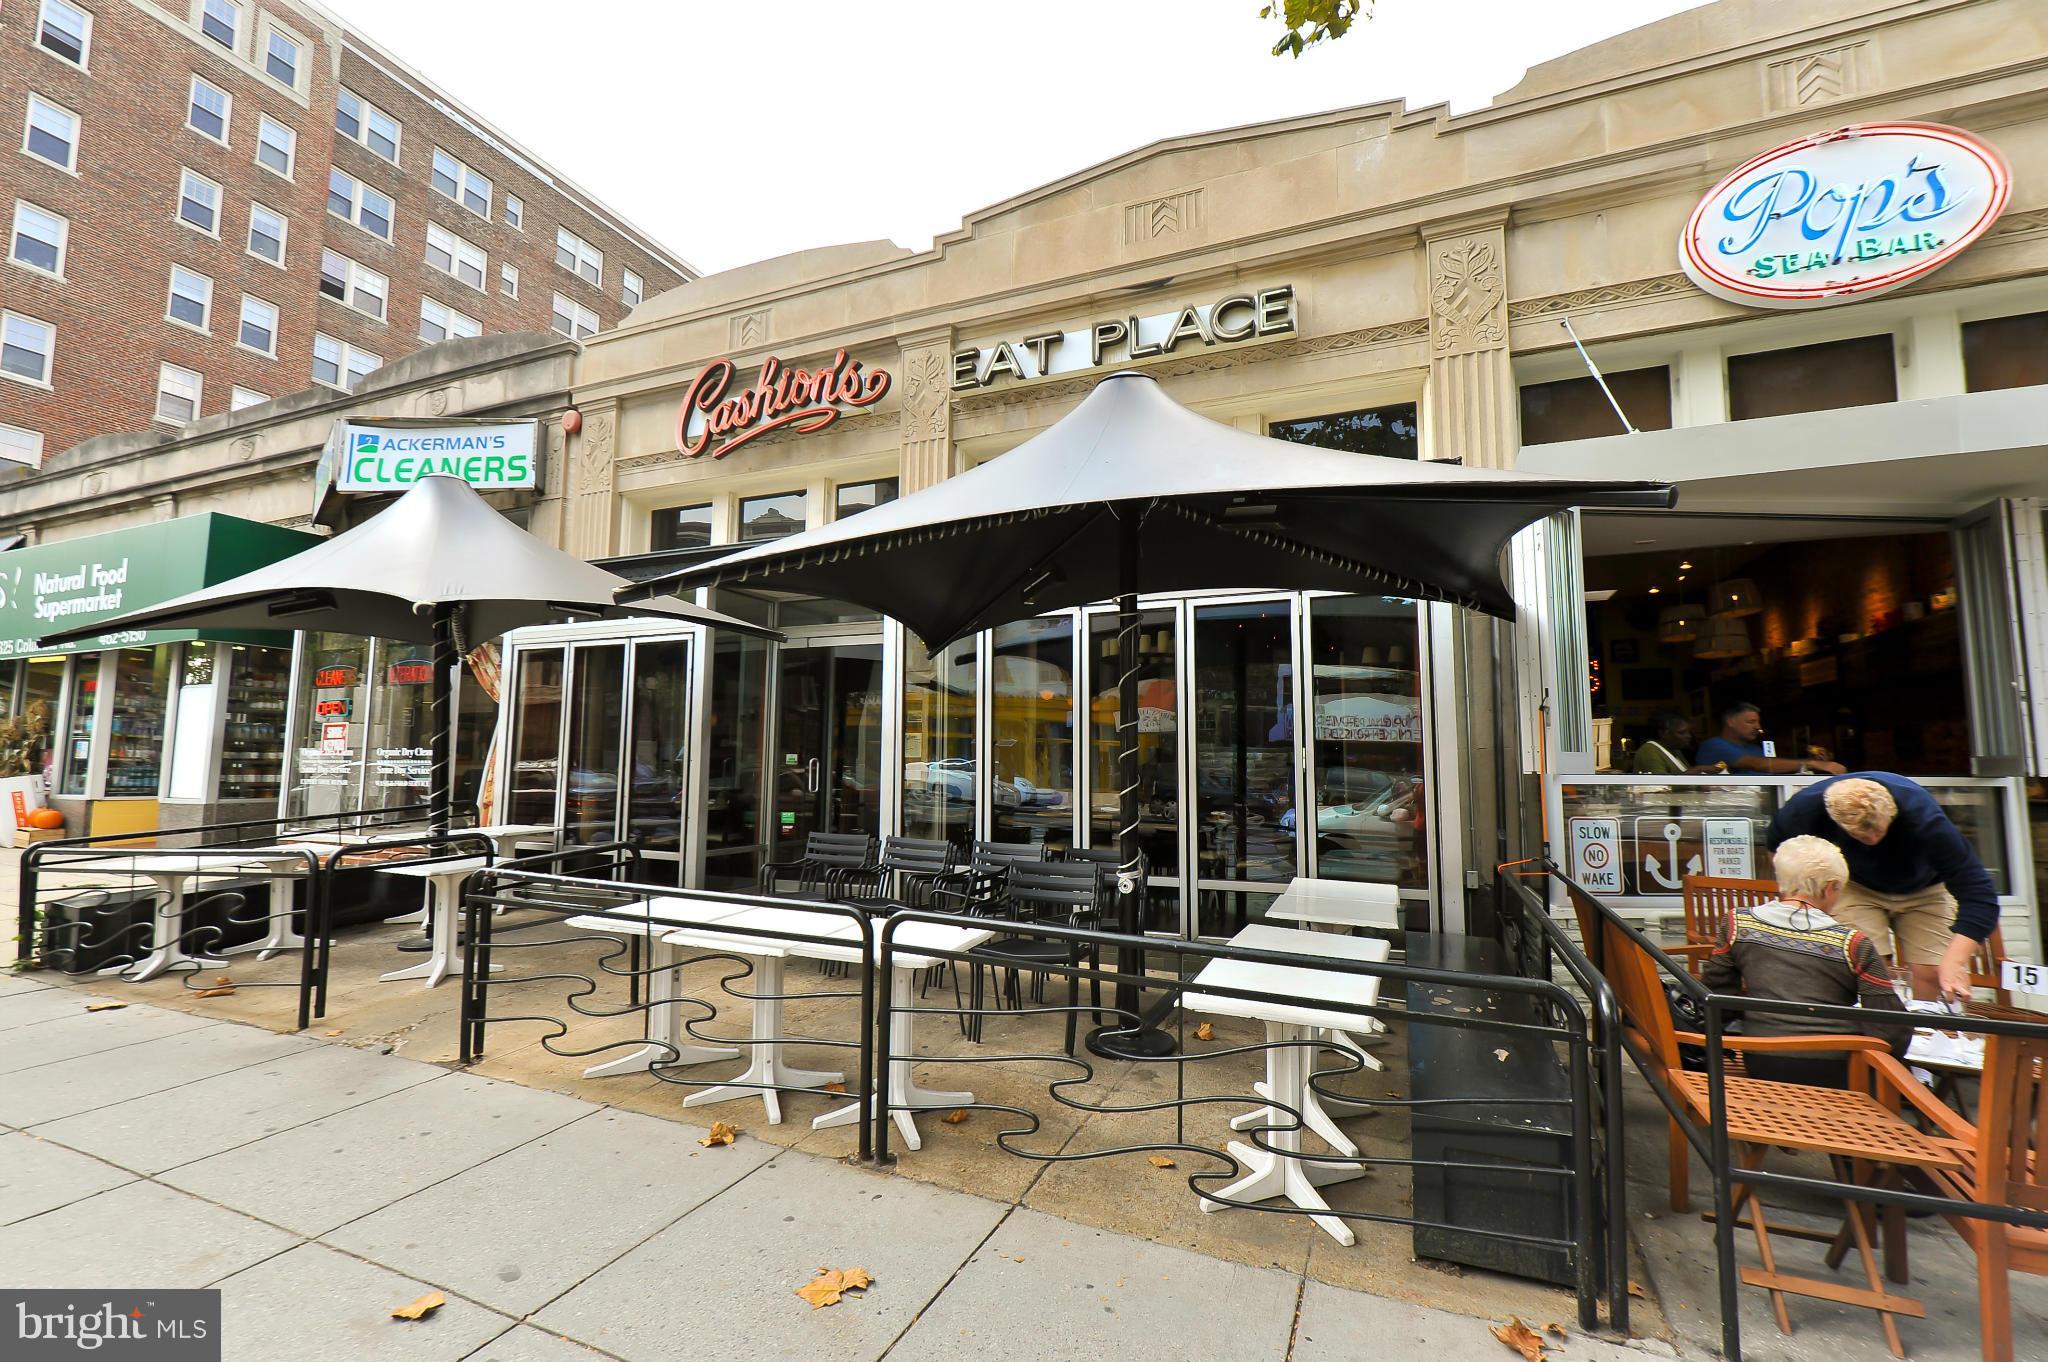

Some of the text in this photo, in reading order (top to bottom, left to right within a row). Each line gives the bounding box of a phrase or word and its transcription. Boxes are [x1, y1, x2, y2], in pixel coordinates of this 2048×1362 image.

[1718, 152, 1976, 265] Pop's
[1751, 230, 1942, 279] SEA BAR
[951, 283, 1298, 391] EAT PLACE
[675, 349, 893, 458] Cashion's
[382, 435, 505, 451] ACKERMAN'S
[354, 455, 527, 483] CLEANERS
[33, 564, 87, 595] Natural
[91, 558, 129, 587] Food
[33, 587, 123, 622] Supermarket
[316, 701, 346, 716] OPEN
[376, 747, 401, 758] Organic
[402, 748, 413, 758] Dry
[377, 765, 431, 776] Same Day Service
[1579, 826, 1610, 839] SLOW
[1588, 850, 1604, 862] NO
[1582, 872, 1614, 885] WAKE
[2012, 965, 2038, 986] 15
